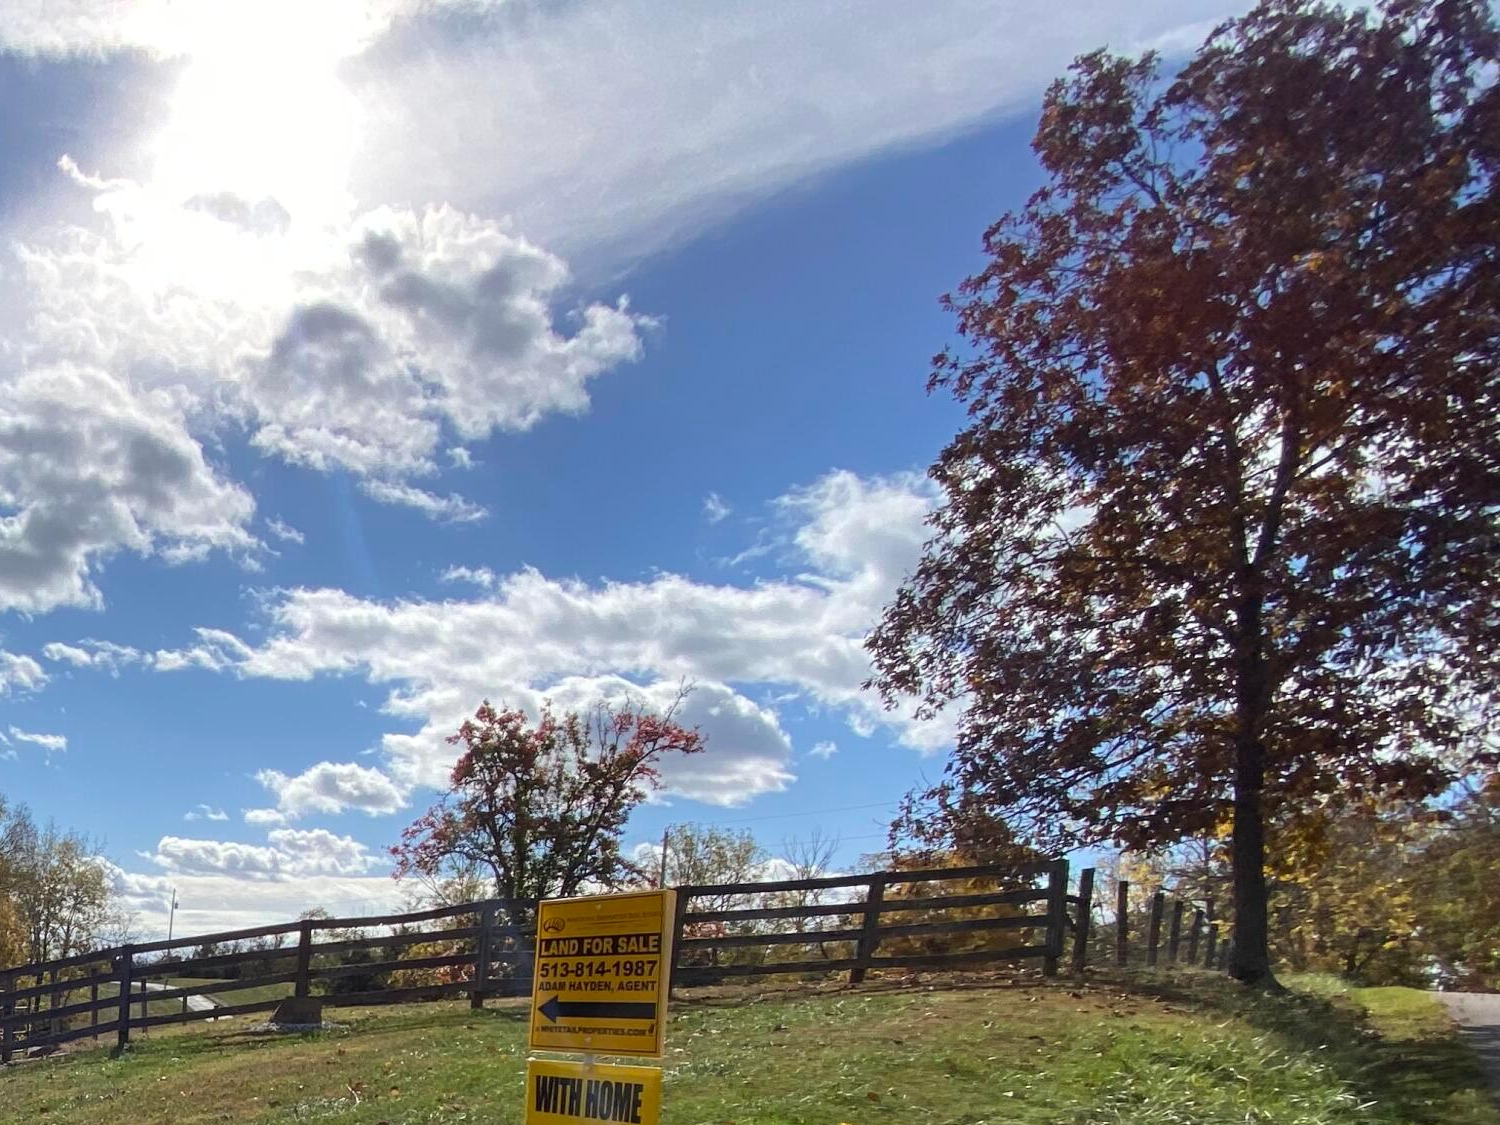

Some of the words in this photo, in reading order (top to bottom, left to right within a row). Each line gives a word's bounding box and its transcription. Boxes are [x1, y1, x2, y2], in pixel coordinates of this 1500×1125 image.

[541, 939, 578, 955] LAND
[583, 938, 613, 954] FOR
[618, 936, 659, 953] SALE
[540, 960, 658, 977] 513-814-1987
[539, 982, 566, 991] ADAM
[617, 980, 657, 991] AGENT
[535, 1075, 583, 1117] WITH
[585, 1079, 644, 1124] HOME
